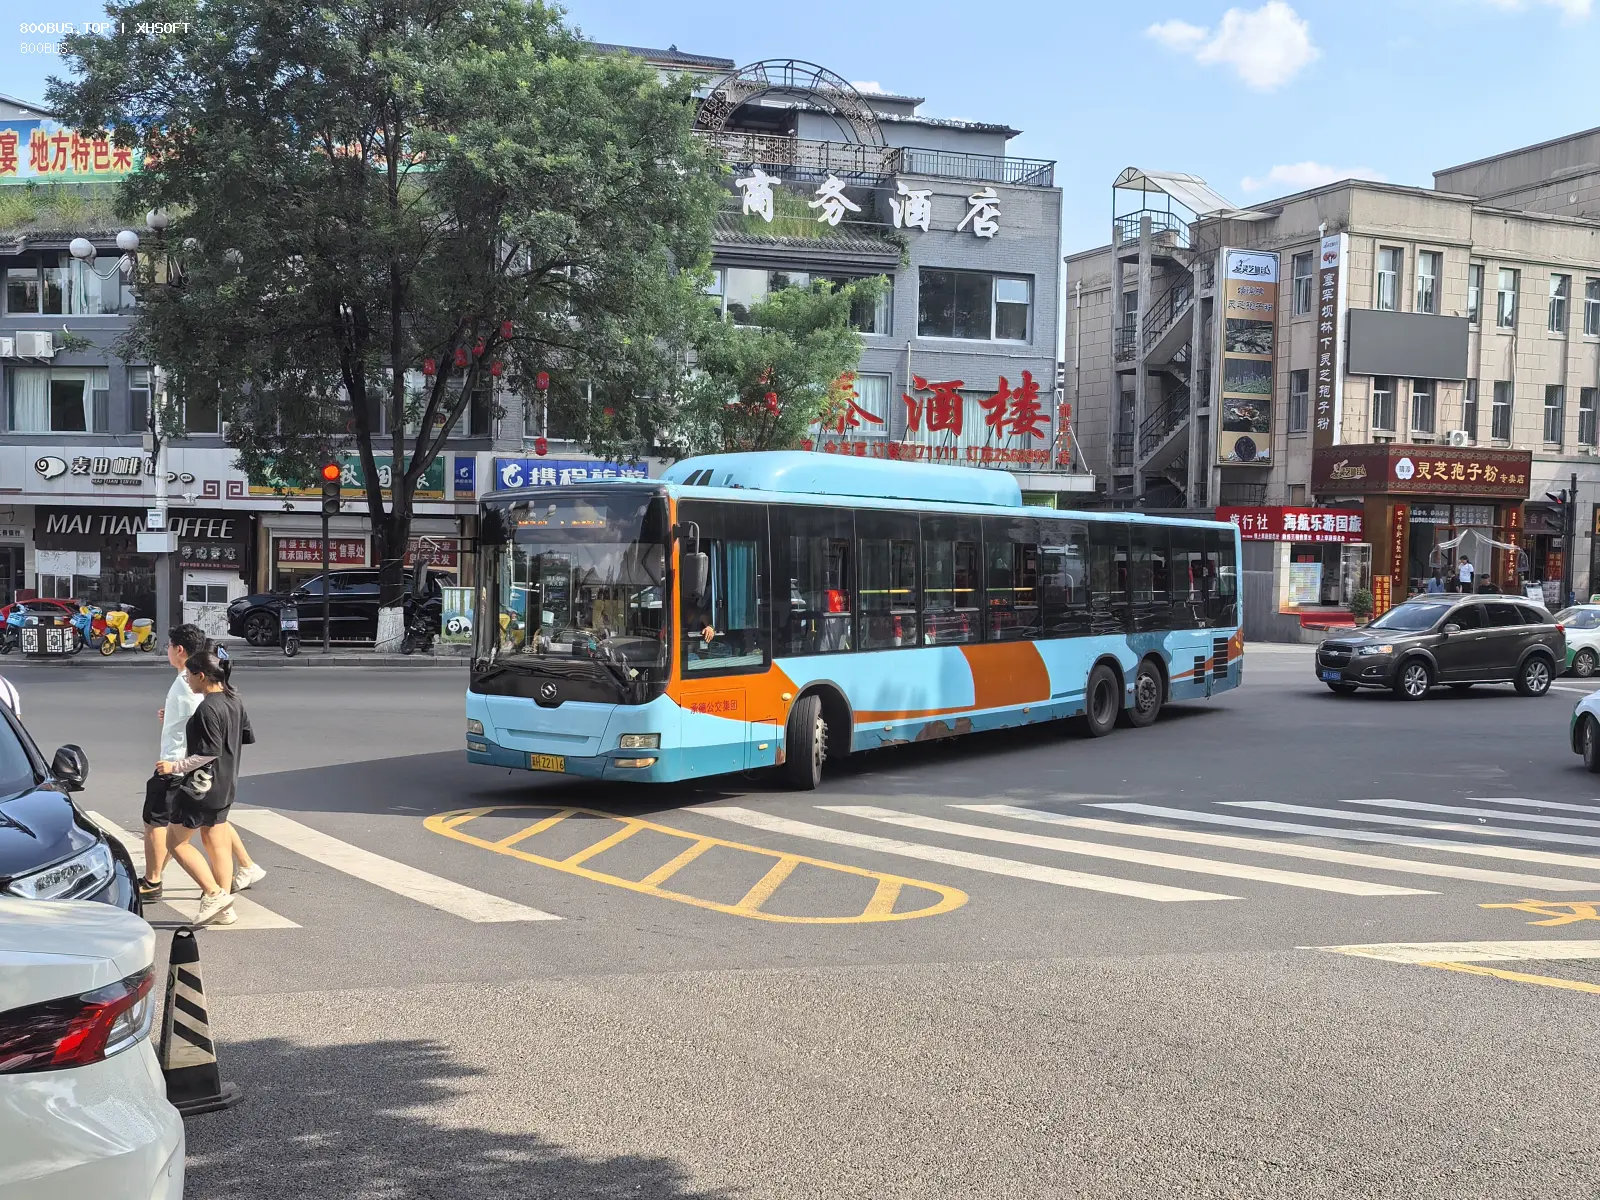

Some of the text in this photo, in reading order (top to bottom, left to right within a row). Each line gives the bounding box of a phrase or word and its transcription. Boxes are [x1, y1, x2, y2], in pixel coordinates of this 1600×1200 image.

[736, 169, 1001, 239] 商务酒店
[1416, 461, 1498, 482] 灵芝孢子粉
[46, 514, 236, 539] MAI TIAN OFFEE
[1283, 512, 1362, 533] 海航乐游国旅
[279, 550, 337, 561] 隆承国际大戏
[339, 543, 364, 558] 售票处
[691, 699, 737, 714] 承德公交集团
